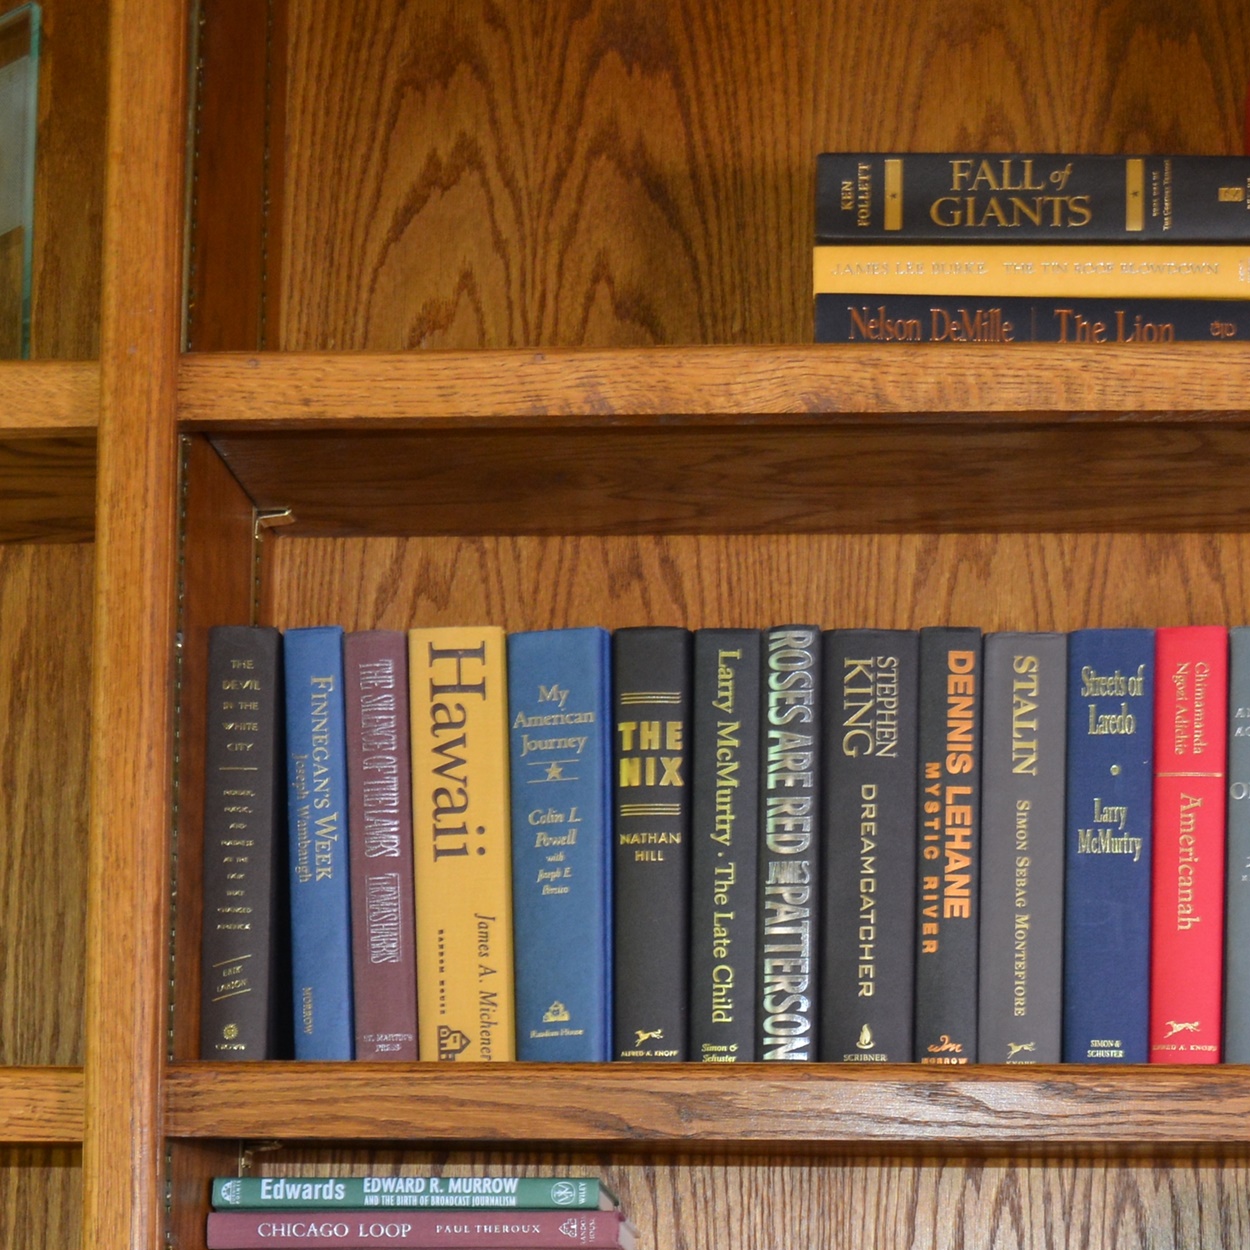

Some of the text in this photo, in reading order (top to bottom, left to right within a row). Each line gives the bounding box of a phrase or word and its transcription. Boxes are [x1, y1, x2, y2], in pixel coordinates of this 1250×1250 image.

[842, 181, 853, 210] KEN
[858, 163, 871, 227] FOLLETT
[950, 160, 1072, 191] FALL of
[930, 197, 1091, 228] GIANTS
[618, 721, 682, 751] THE
[842, 657, 873, 757] KING
[875, 656, 898, 758] STEPHEN
[1011, 655, 1039, 776] STALIN
[428, 640, 486, 862] Hawaii
[619, 757, 684, 787] NIX
[711, 648, 742, 846] Larry McMurtry
[944, 650, 975, 919] DENNIS LEHANE
[620, 832, 681, 846] NATHAN
[635, 850, 664, 862] HILL
[922, 762, 940, 954] MYSTIC RIVER
[1177, 792, 1202, 931] Americanah
[858, 784, 878, 997] DREAMCATCHER
[1014, 800, 1030, 1017] SIMON SEBAG MONTEFIORE
[712, 862, 734, 1023] The Late Child
[475, 913, 500, 1060] James A. Michener
[843, 1053, 887, 1062] SCRIBNER
[260, 1178, 345, 1201] Edwards
[363, 1177, 518, 1194] EDWARD R. MURROW
[258, 1222, 411, 1238] CHICAGO LOOP
[436, 1224, 540, 1234] PAUL THEROUX
